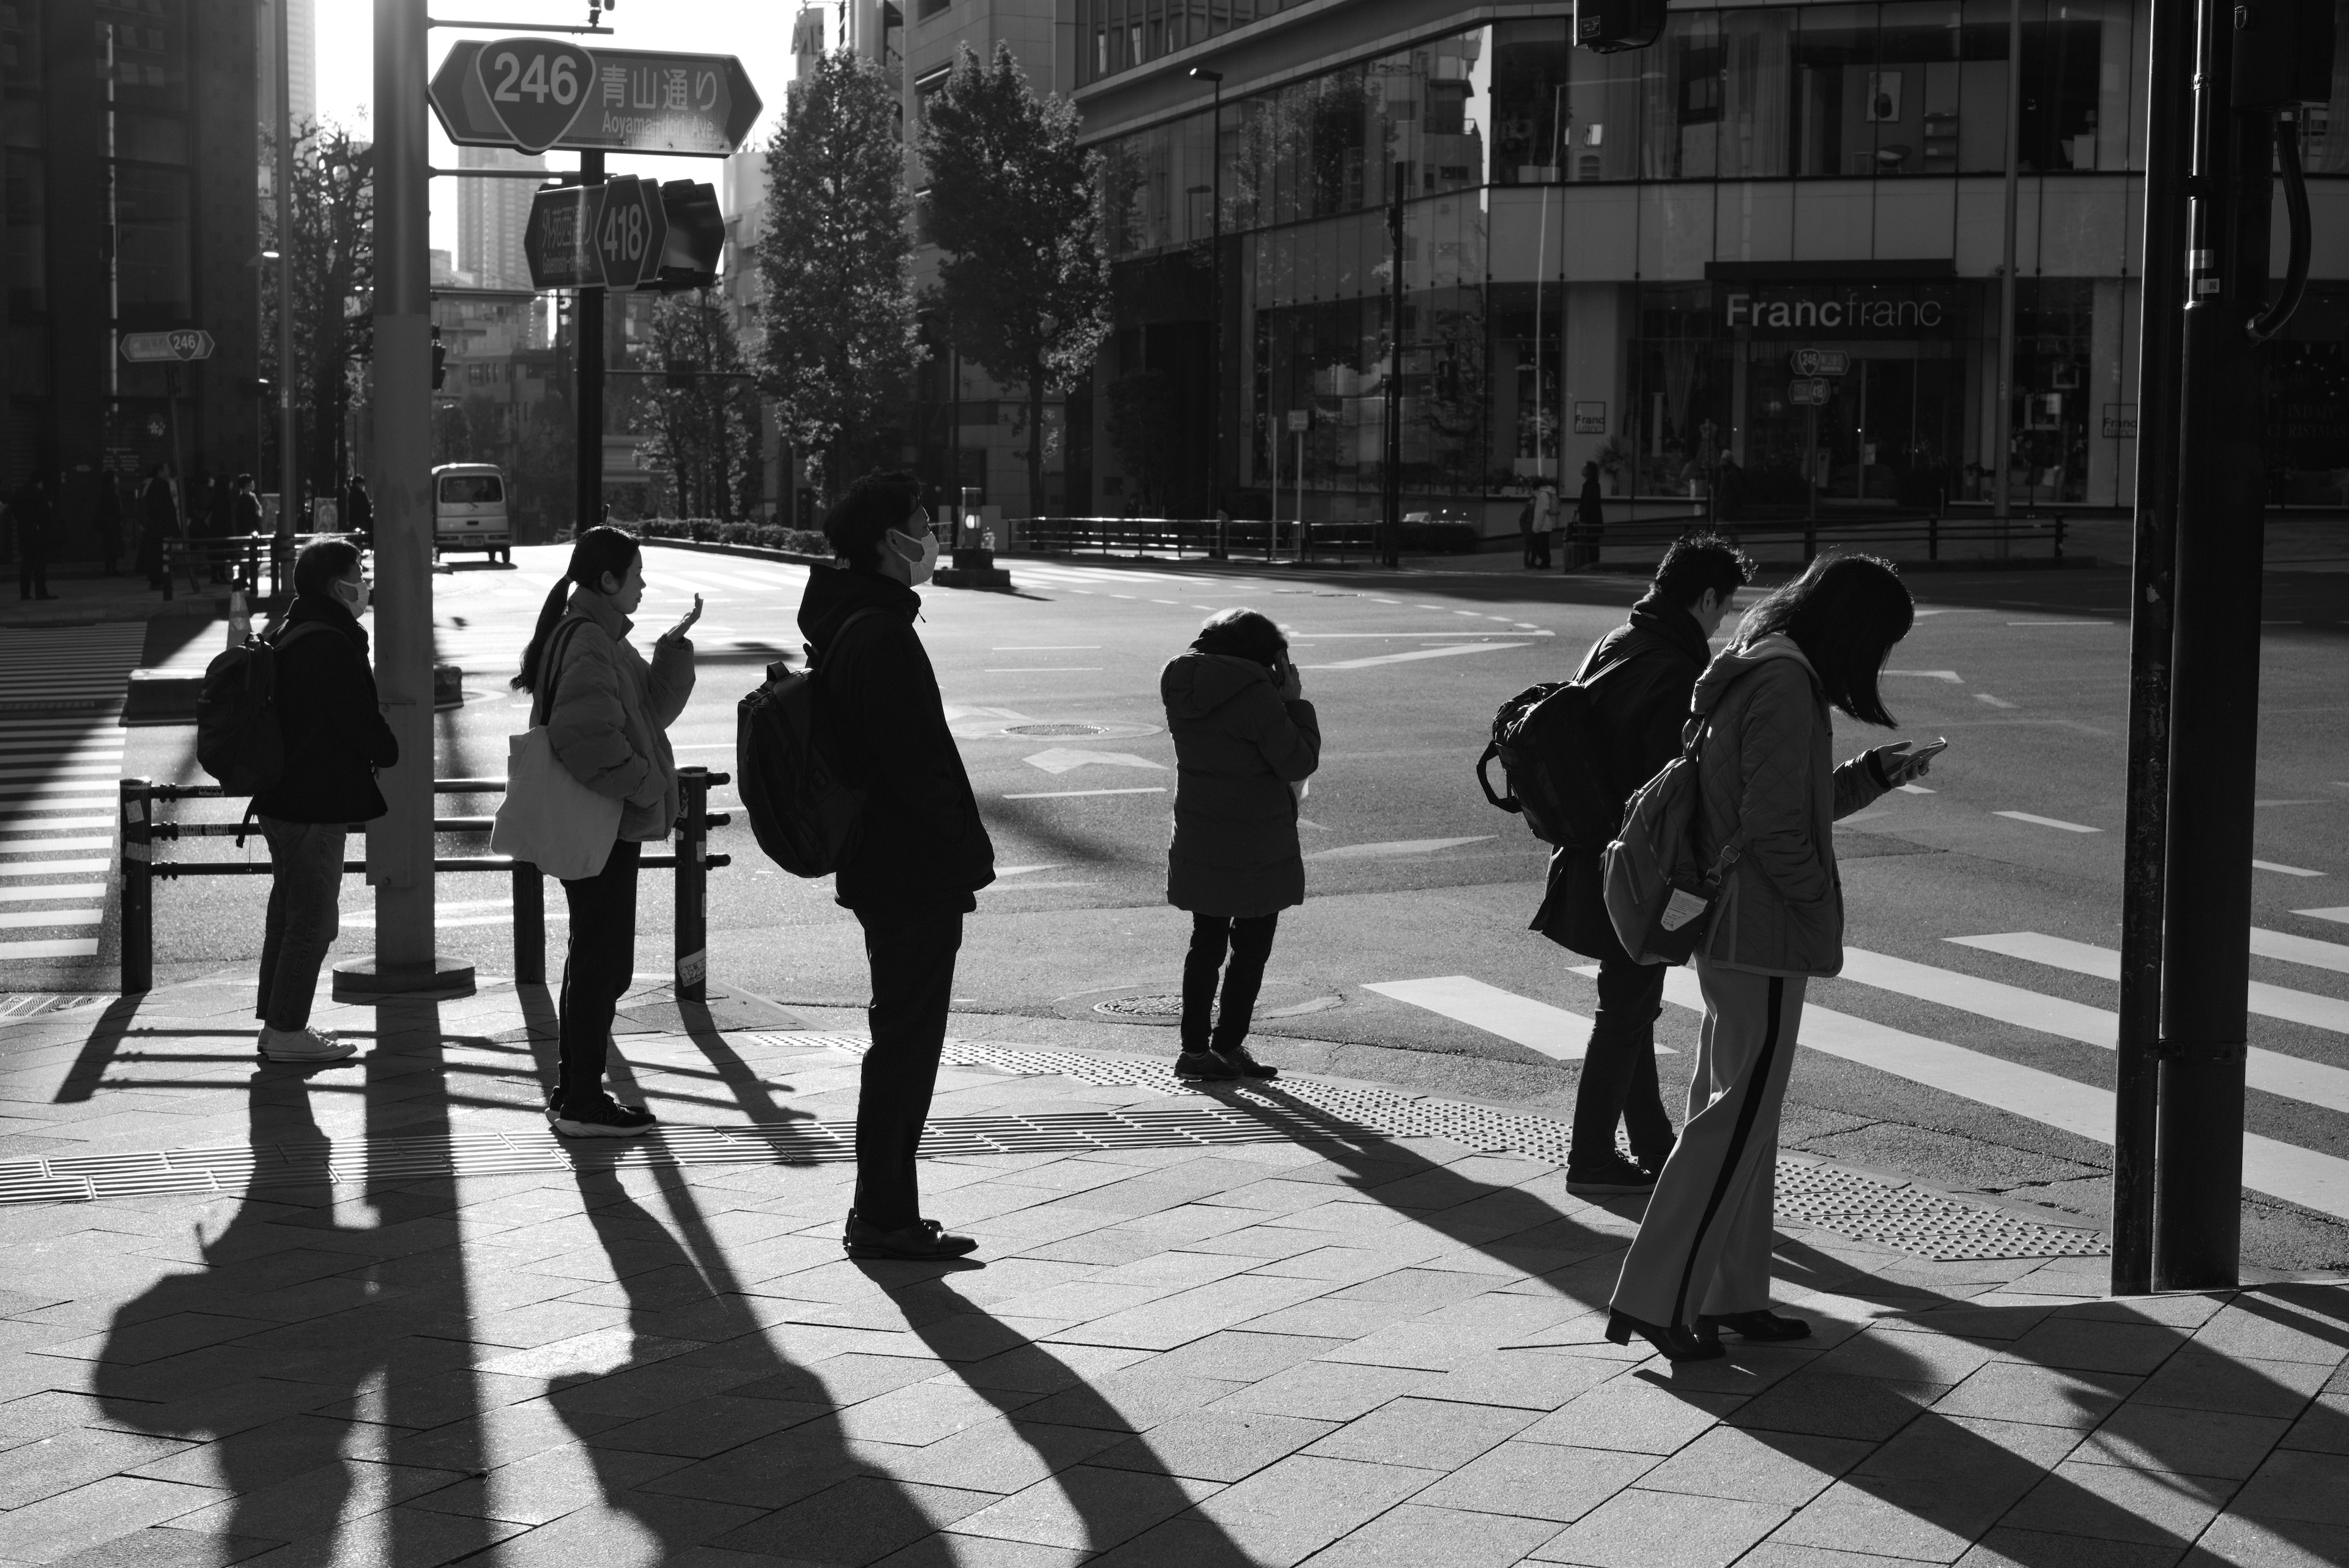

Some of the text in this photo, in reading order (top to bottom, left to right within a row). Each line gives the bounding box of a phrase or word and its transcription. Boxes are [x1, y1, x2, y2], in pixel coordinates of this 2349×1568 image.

[494, 52, 577, 105] 246
[601, 64, 717, 111] 青山通り
[602, 111, 716, 139] Aoyama-dori Ave.
[604, 204, 642, 262] 418
[1727, 293, 1942, 327] Francfranc
[173, 335, 196, 349] 246
[1803, 353, 1817, 366] 246
[1812, 385, 1823, 398] 418
[1575, 414, 1605, 425] Franc
